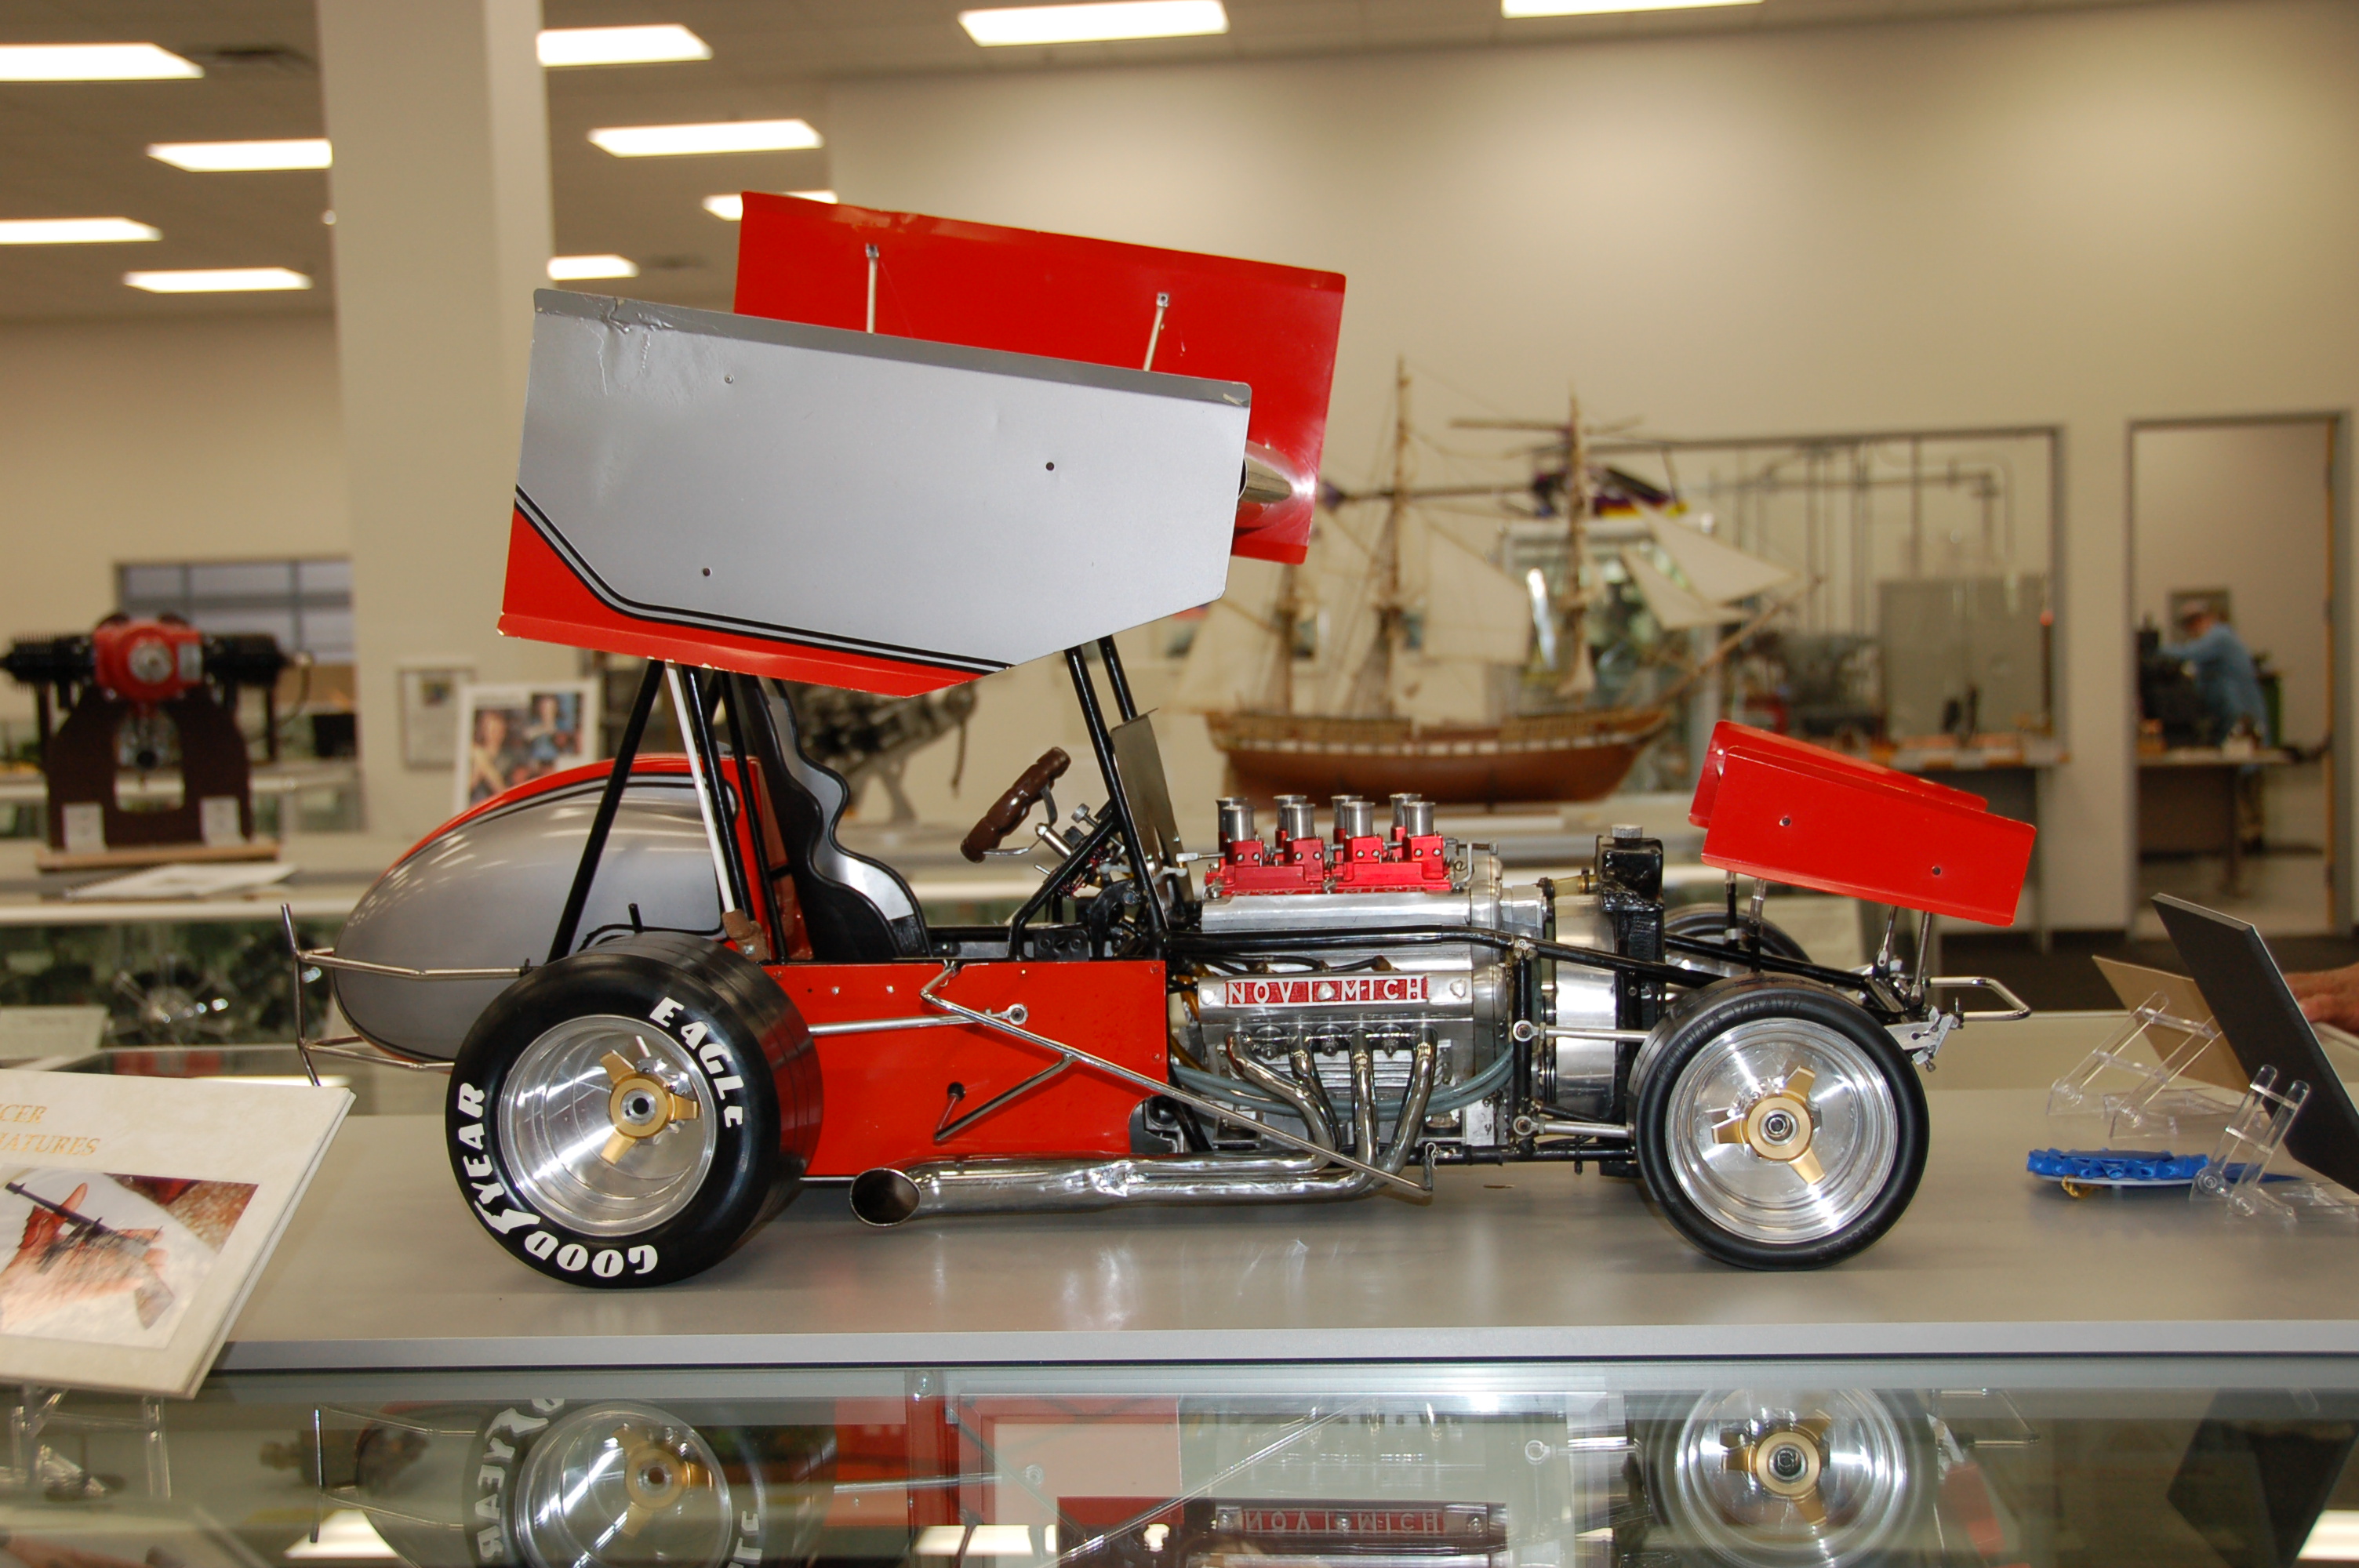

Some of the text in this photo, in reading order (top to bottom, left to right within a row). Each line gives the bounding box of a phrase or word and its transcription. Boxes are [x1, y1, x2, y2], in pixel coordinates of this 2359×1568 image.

[1227, 979, 1423, 1004] NOVI MICH
[649, 996, 744, 1128] EAGLE
[0, 1104, 48, 1123] CER
[457, 1082, 659, 1278] GOODYEAR
